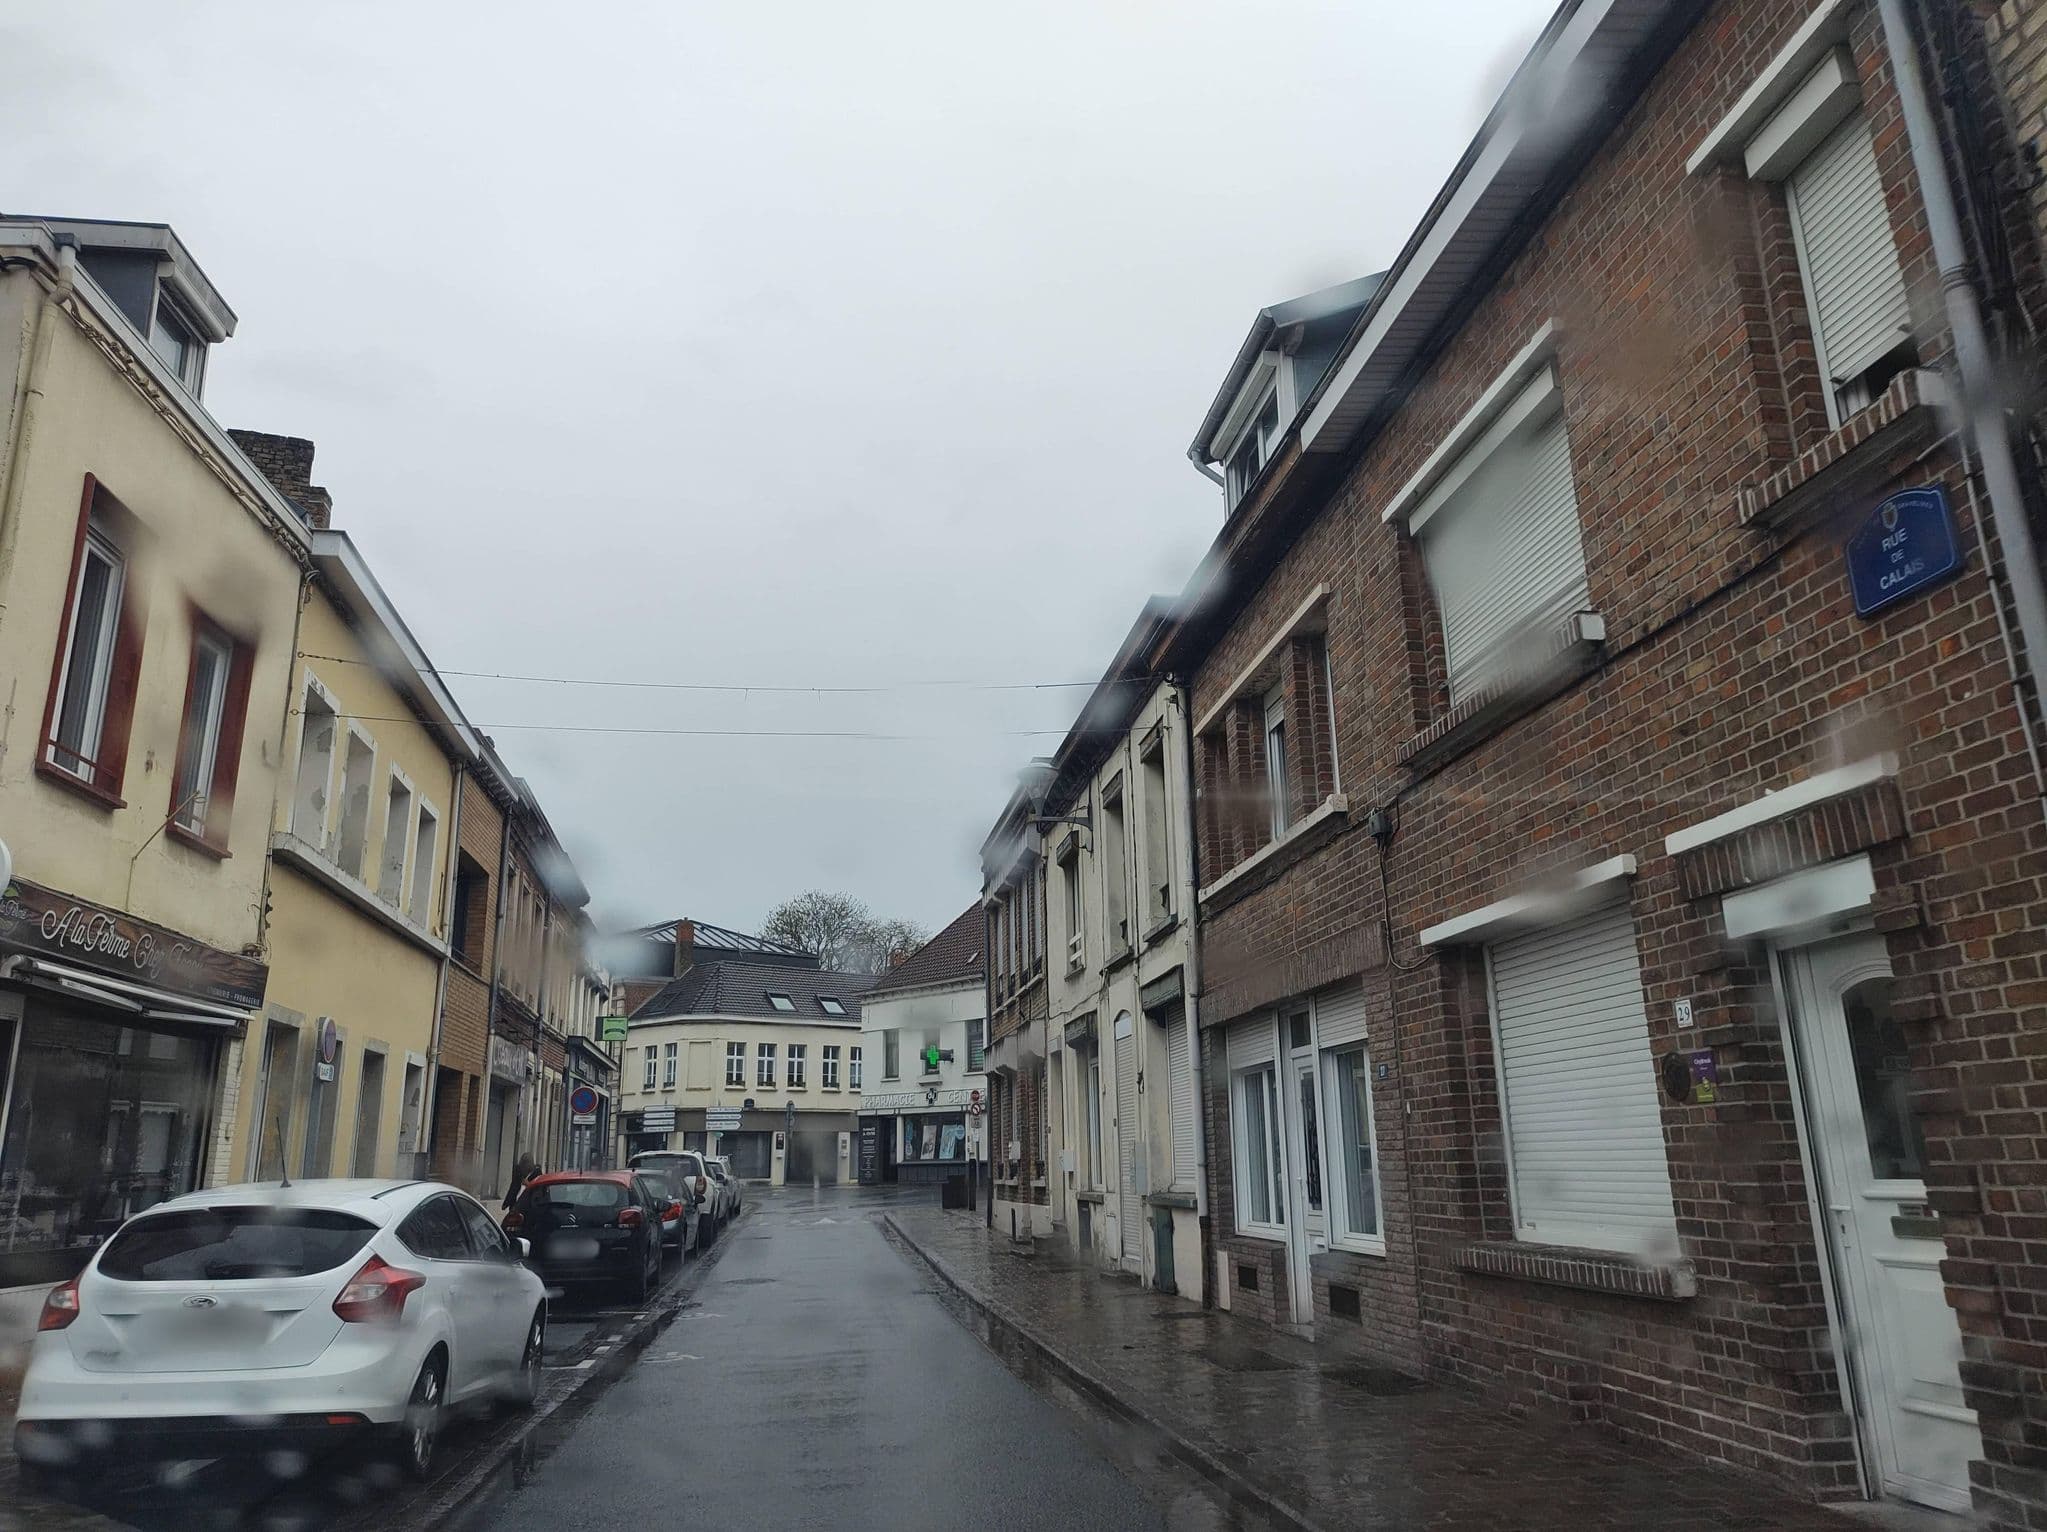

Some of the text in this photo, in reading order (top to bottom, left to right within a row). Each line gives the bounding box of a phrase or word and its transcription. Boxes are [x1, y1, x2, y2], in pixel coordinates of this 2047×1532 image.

[1881, 527, 1908, 553] RUE
[1890, 548, 1905, 564] DE
[1879, 558, 1925, 590] CALAIS
[41, 906, 80, 948] A
[71, 912, 87, 946] la
[84, 912, 131, 959] Ferme
[1677, 1006, 1691, 1022] 29
[863, 1093, 916, 1108] PHARMACIE
[947, 1088, 985, 1104] CENTE
